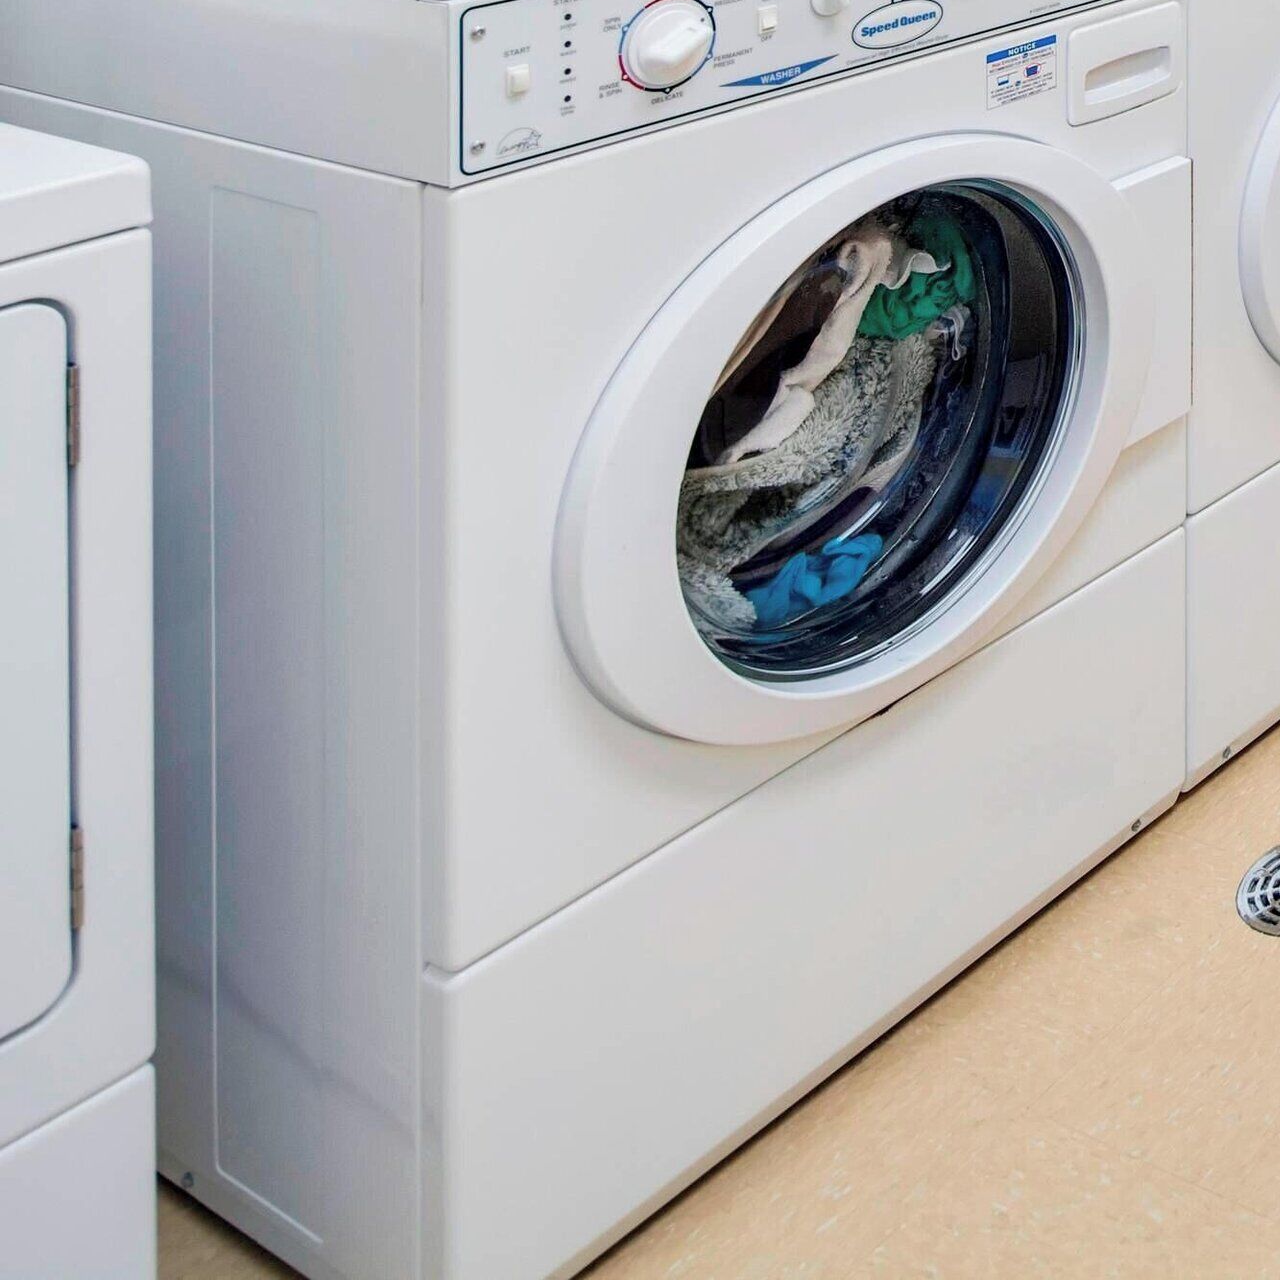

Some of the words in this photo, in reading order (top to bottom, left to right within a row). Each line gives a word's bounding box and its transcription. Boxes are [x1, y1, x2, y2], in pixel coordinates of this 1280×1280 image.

[860, 19, 899, 37] Speed
[900, 10, 937, 27] Queen
[503, 46, 531, 58] START
[713, 48, 753, 62] PERMANENT
[1008, 42, 1036, 56] NOTICE
[713, 60, 735, 69] PRESS
[760, 66, 801, 84] WASHER
[651, 91, 684, 104] DELICATE
